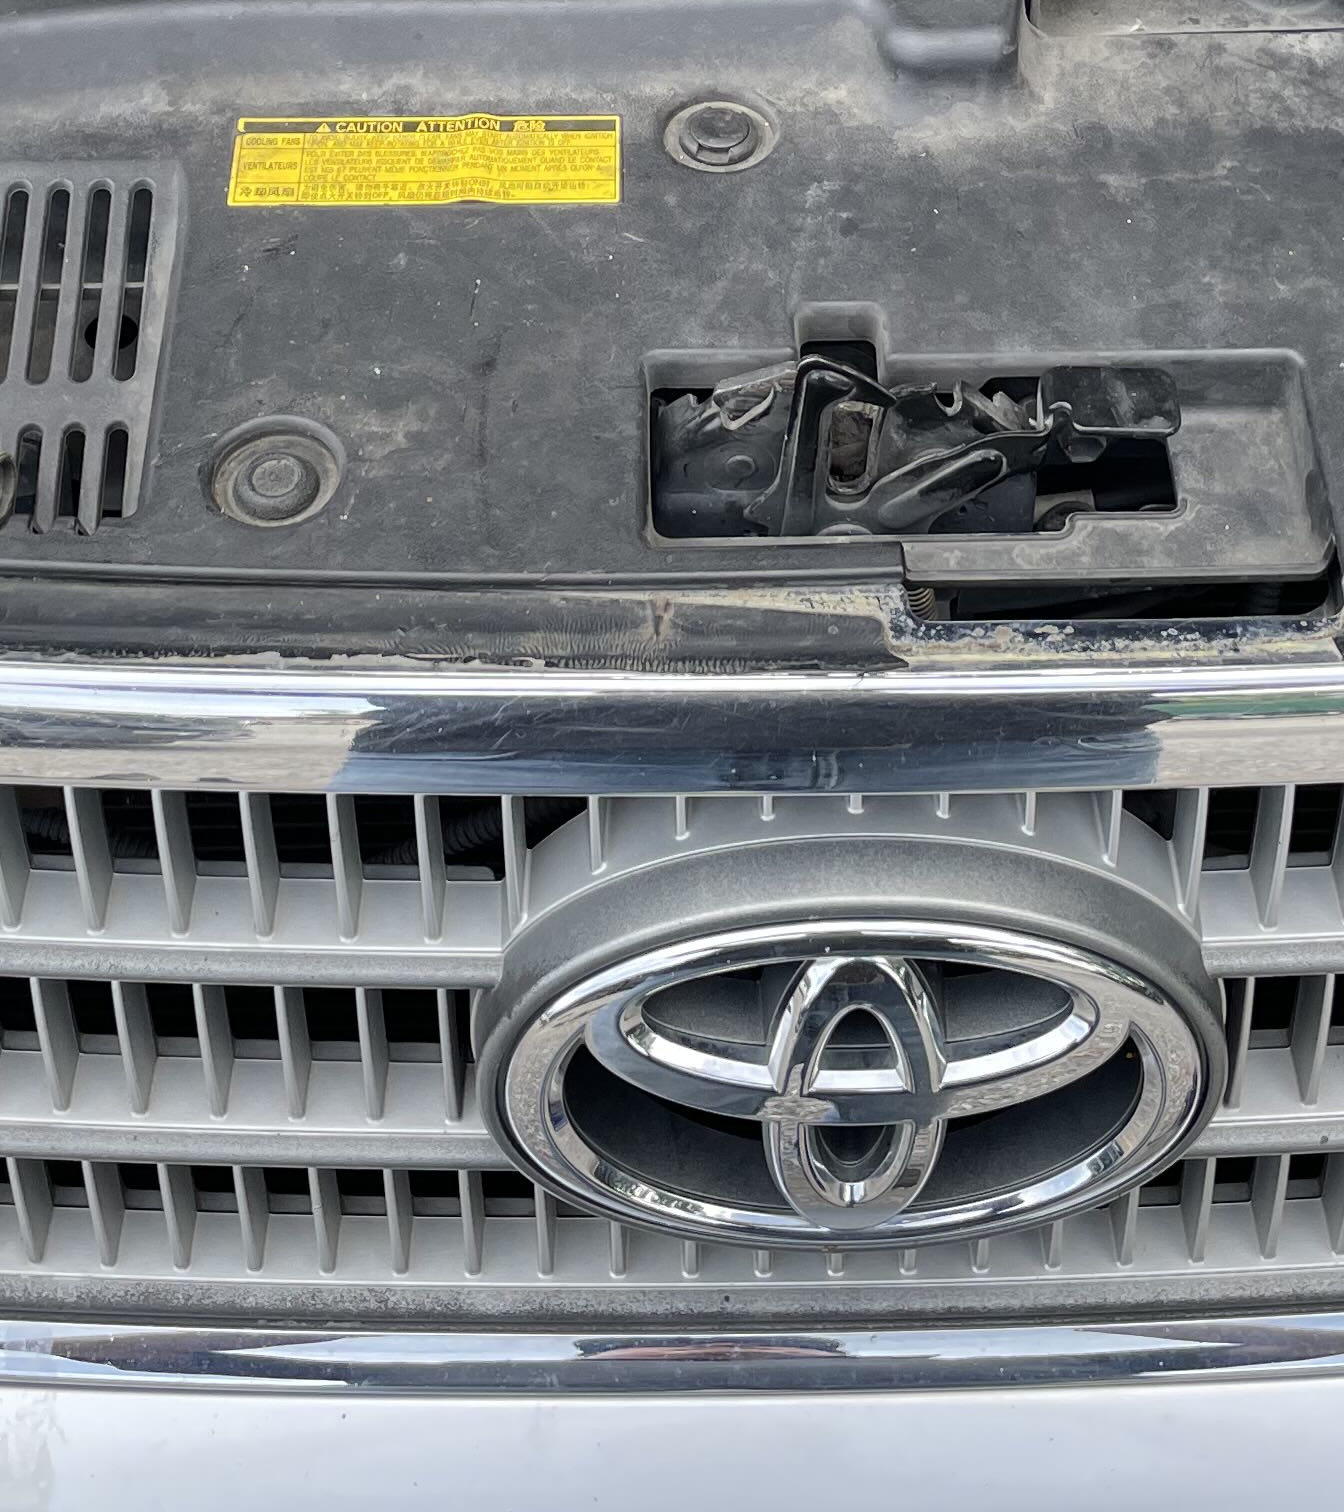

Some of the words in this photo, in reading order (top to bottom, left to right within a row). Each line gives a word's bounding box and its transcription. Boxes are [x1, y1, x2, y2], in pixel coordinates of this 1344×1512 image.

[335, 122, 403, 133] CAUTION
[416, 117, 500, 132] ATTENTION
[245, 137, 278, 146] COOLING
[281, 137, 301, 146] FANS
[243, 161, 298, 171] VENTILATEURS
